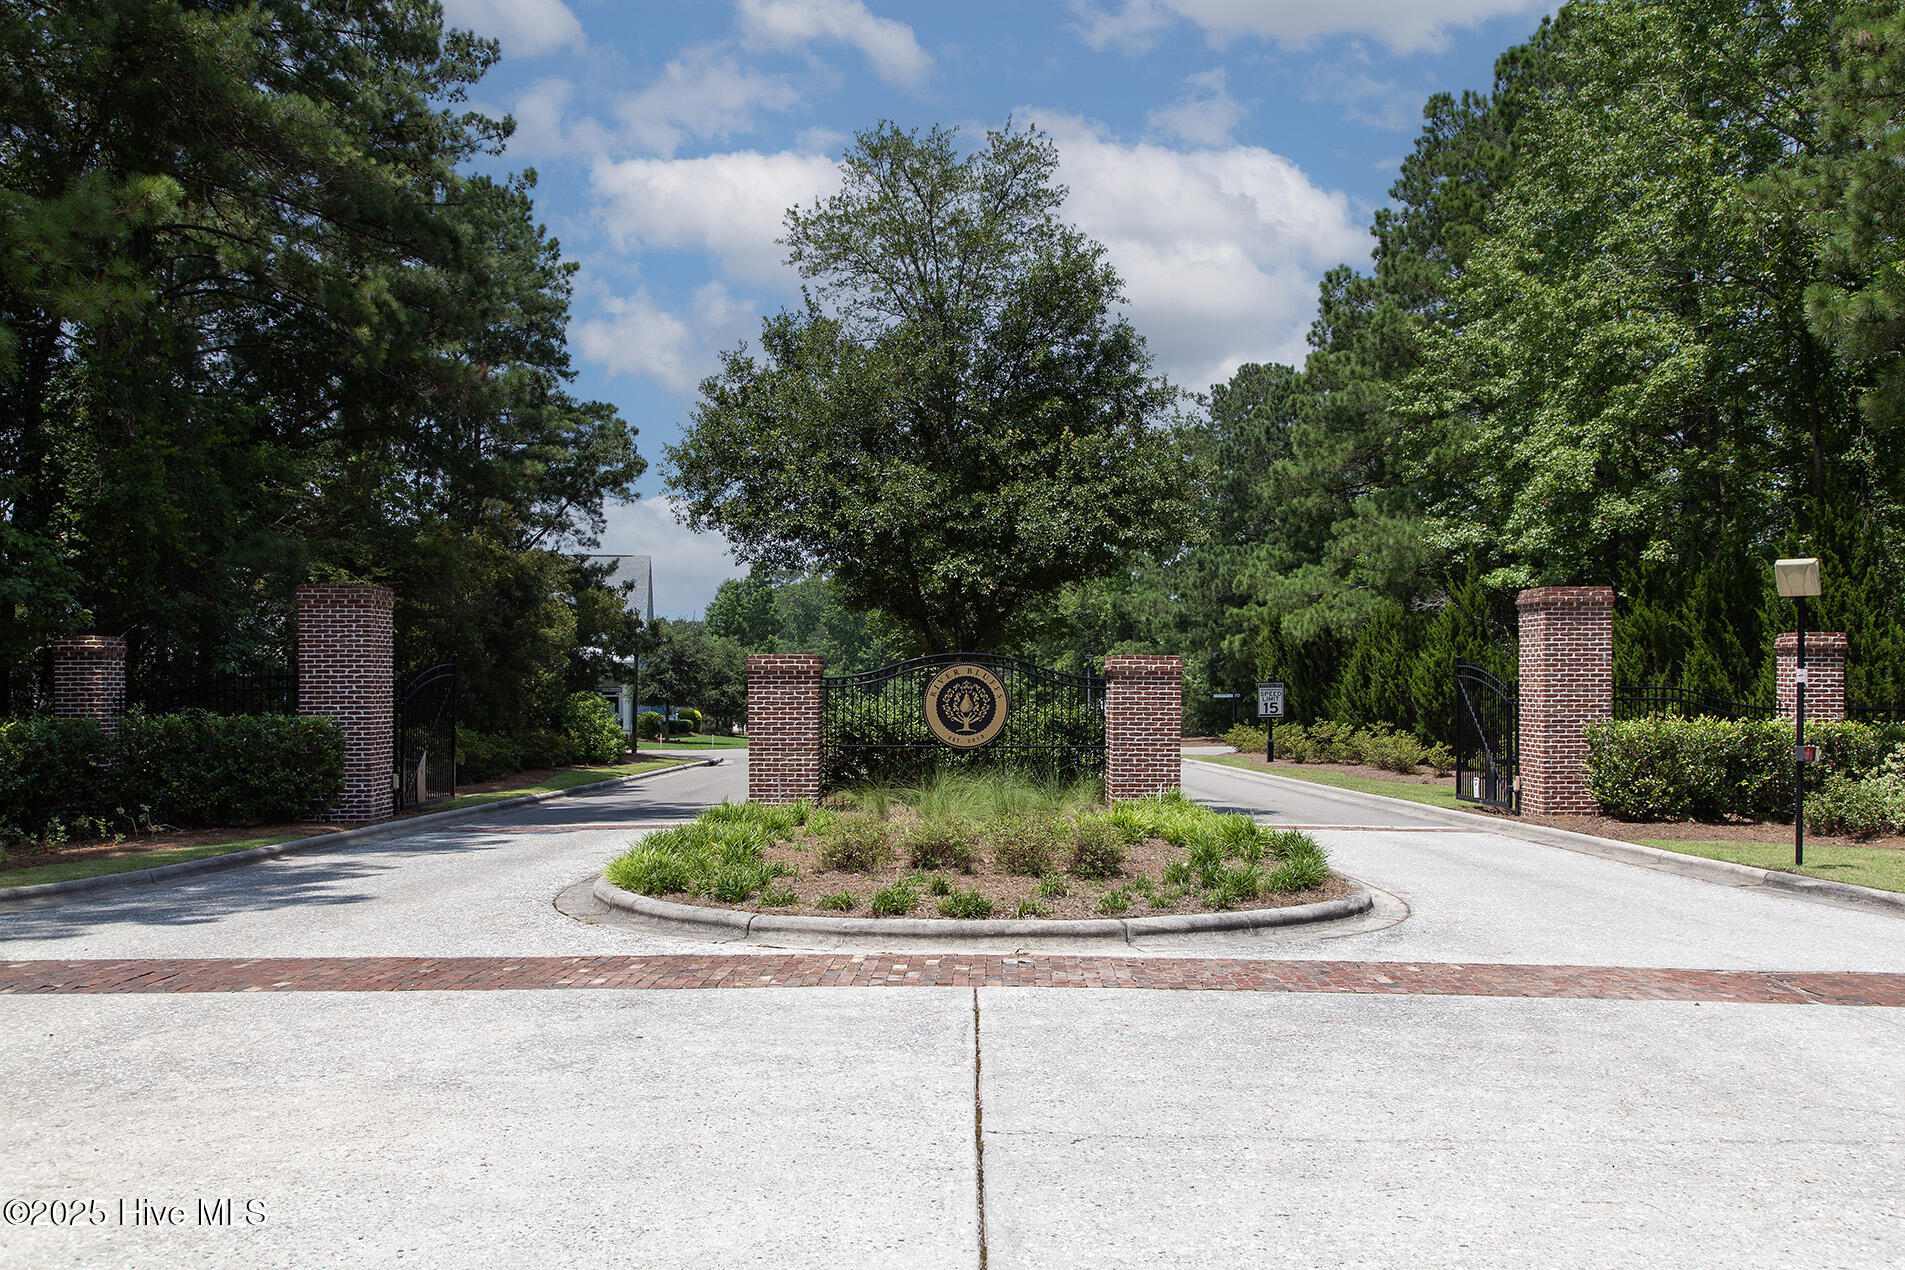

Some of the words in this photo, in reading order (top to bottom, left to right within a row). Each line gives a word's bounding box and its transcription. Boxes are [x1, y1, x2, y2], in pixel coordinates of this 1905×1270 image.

[930, 669, 960, 697] RIVER
[967, 668, 1003, 699] BLUFFS
[1264, 702, 1278, 713] 15
